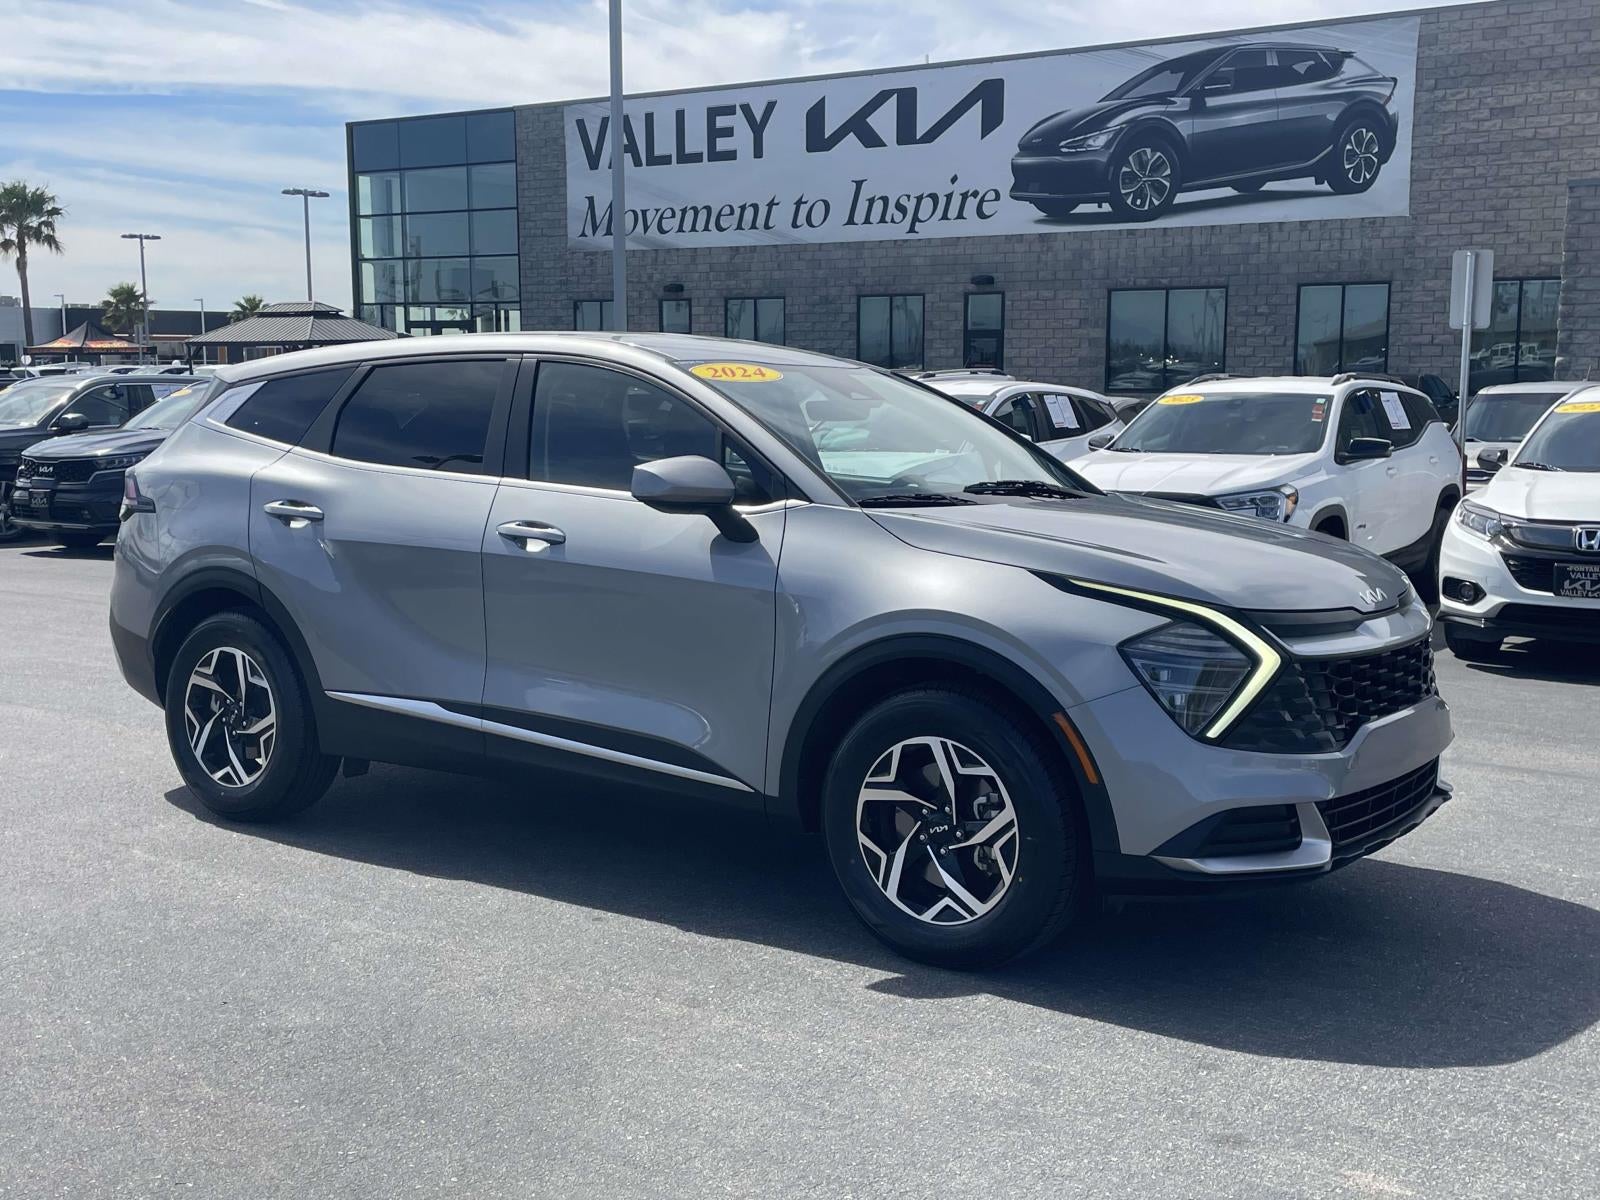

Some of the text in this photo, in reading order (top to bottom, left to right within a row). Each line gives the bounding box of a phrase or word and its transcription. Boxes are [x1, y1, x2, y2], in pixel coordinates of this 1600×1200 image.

[575, 78, 1005, 171] VALLEY KIA
[578, 174, 1001, 238] Movement to Inspire
[706, 367, 767, 378] 2024
